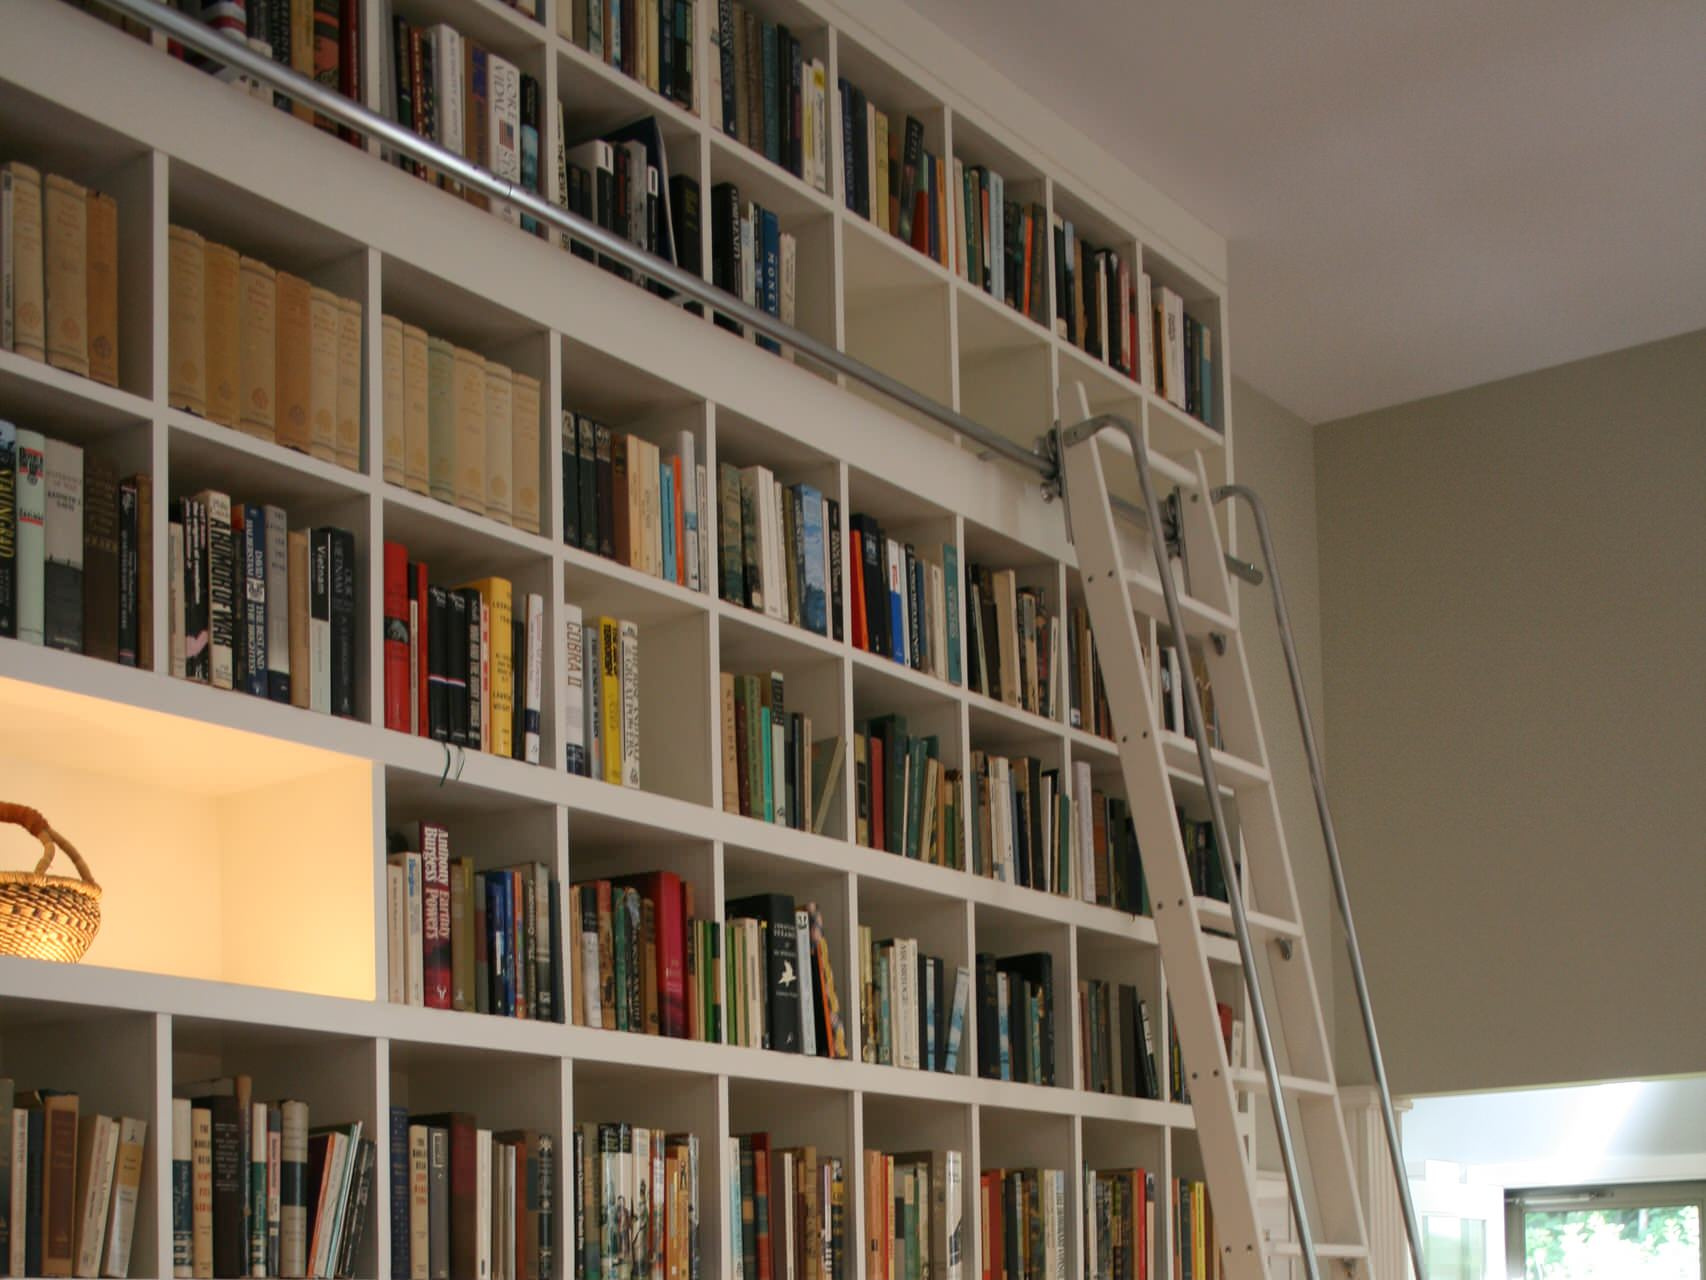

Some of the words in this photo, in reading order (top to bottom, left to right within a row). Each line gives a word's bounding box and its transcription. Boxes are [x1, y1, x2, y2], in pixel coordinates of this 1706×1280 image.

[493, 64, 505, 113] VIDAL
[505, 71, 517, 123] GORE
[767, 251, 776, 313] MONEY
[211, 531, 232, 586] RUMOR
[316, 545, 327, 594] Vietnam
[211, 609, 233, 649] WAR
[256, 625, 265, 647] BEST
[566, 621, 582, 672] COBRA
[422, 826, 438, 882] Burgess
[436, 829, 449, 886] Anthony
[424, 887, 438, 939] Powers
[438, 890, 450, 940] Earthly
